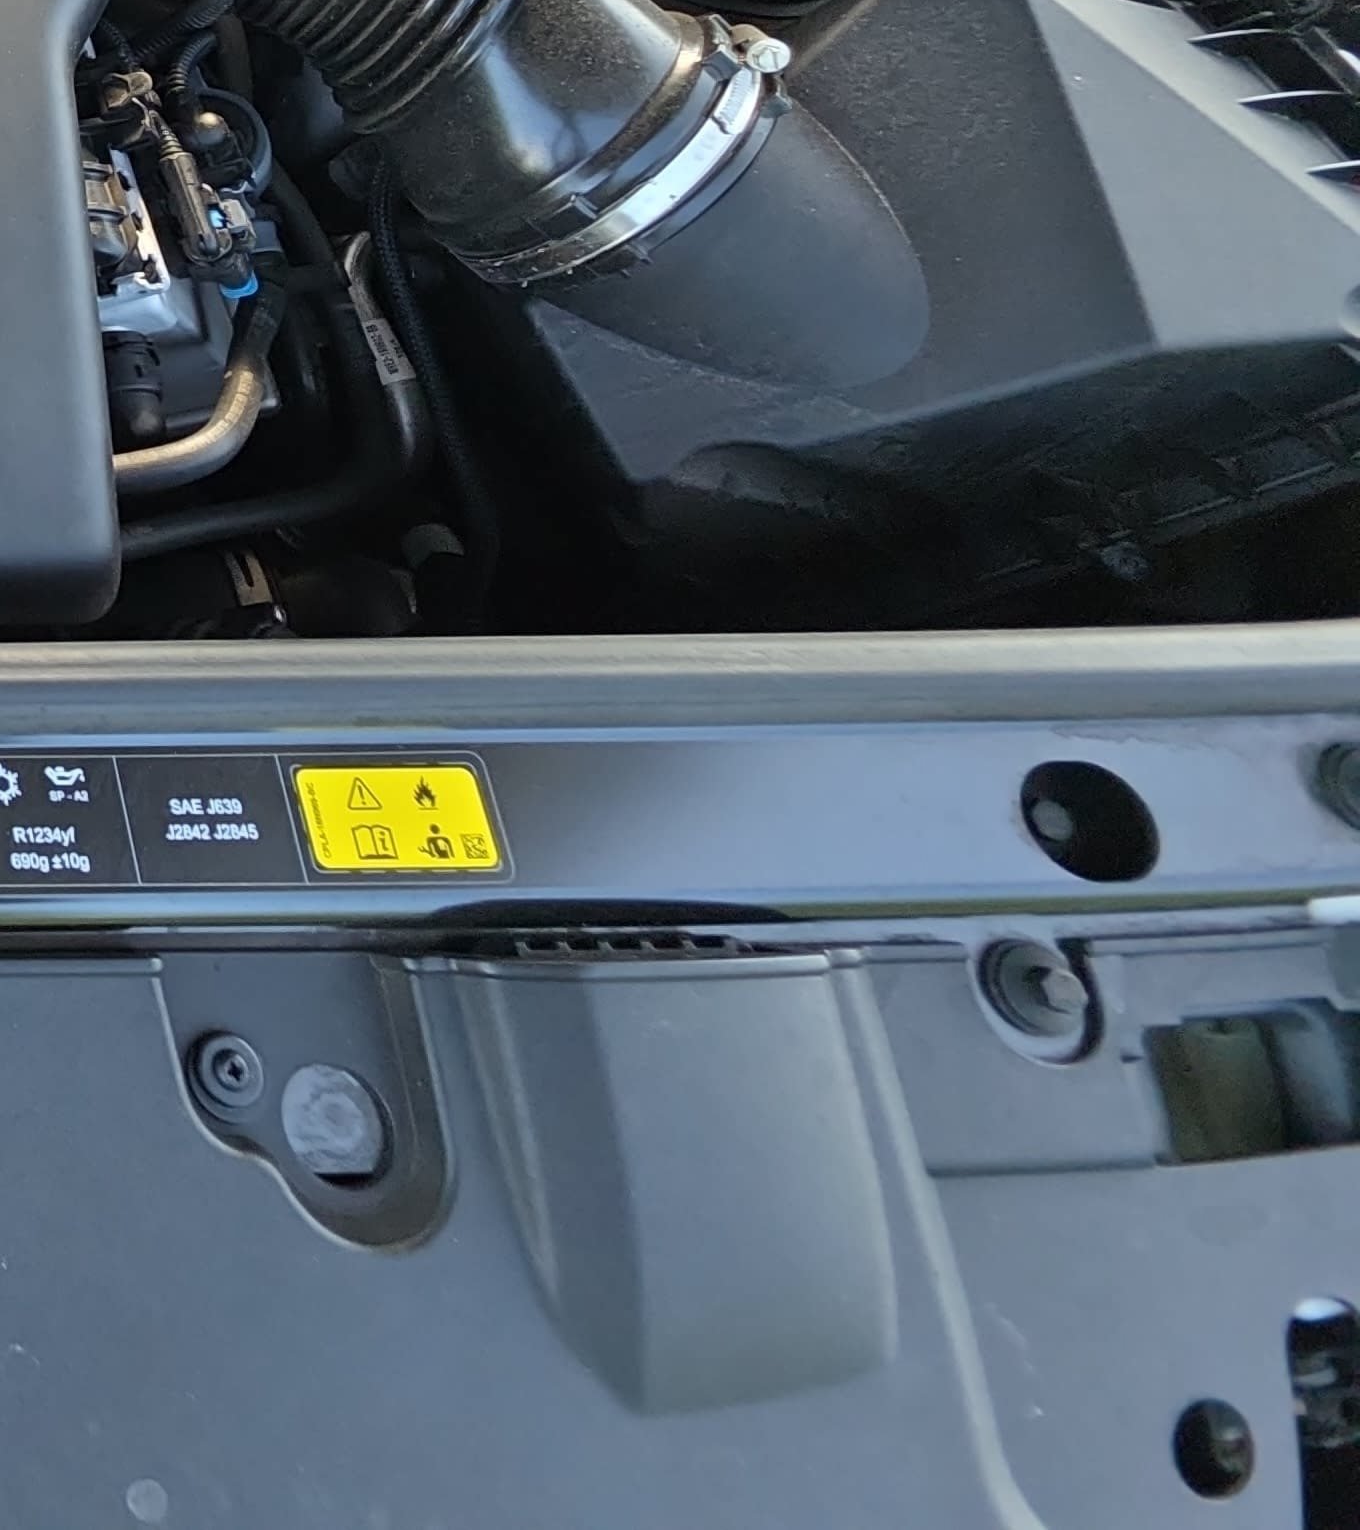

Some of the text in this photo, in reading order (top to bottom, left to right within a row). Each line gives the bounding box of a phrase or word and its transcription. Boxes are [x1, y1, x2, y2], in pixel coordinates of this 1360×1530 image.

[168, 798, 243, 816] SAE J639
[165, 823, 260, 841] J2842 J2845
[10, 852, 50, 873] 690g
